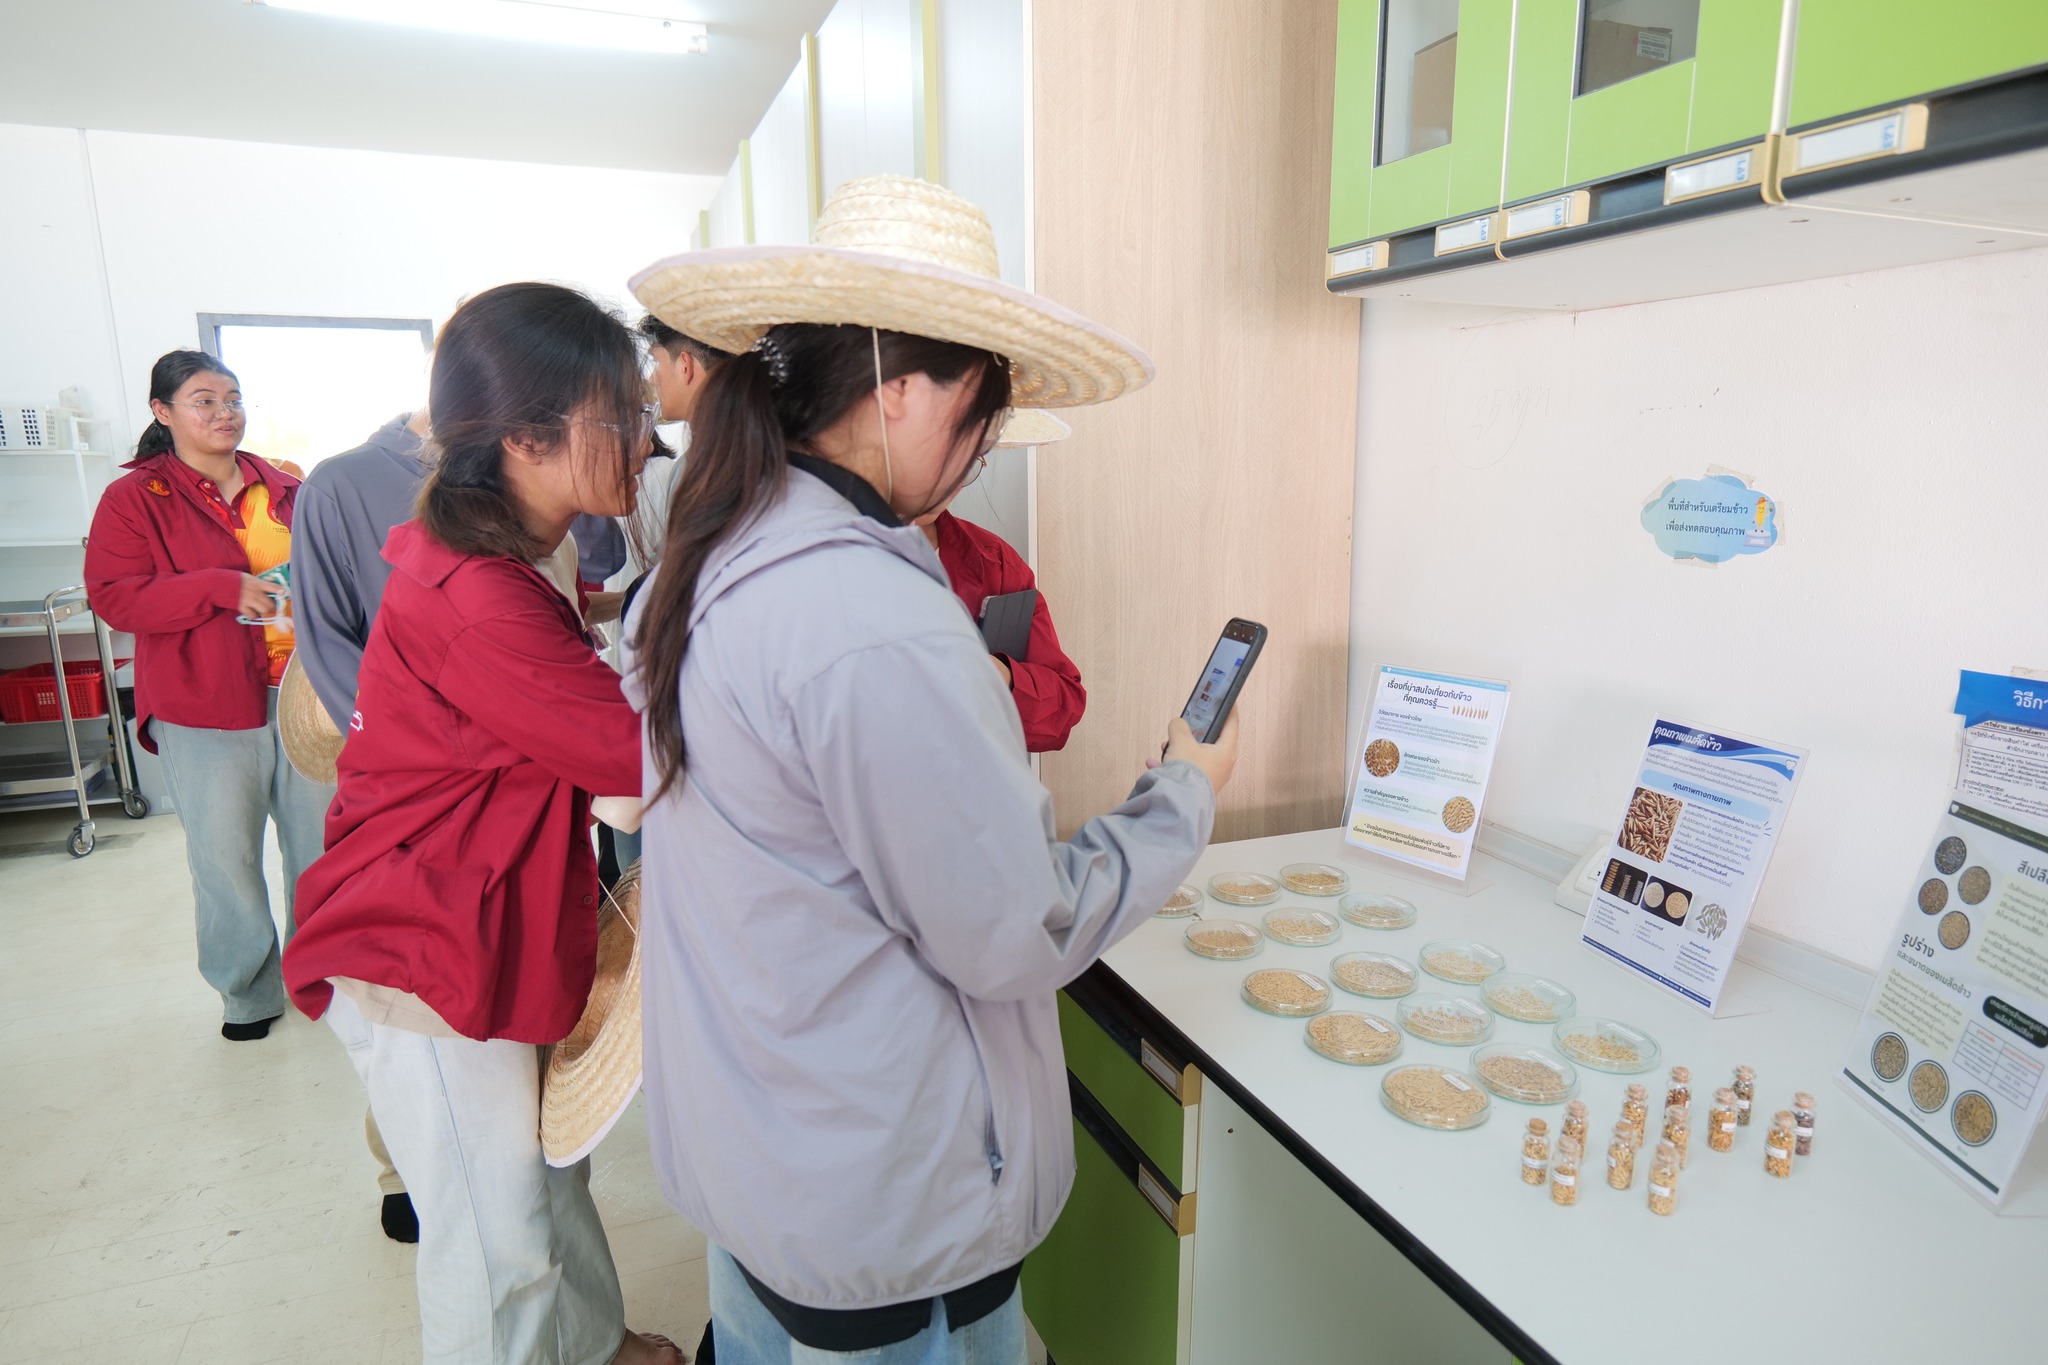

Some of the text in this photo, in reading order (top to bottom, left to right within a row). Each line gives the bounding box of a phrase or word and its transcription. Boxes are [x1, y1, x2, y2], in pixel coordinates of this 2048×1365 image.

[1668, 497, 1748, 515] พื้นที่สำหรับเตรียมข้าว
[1666, 519, 1745, 537] เพื่อส่งทดสอบคุณภาพ
[1654, 726, 1722, 752] คุณภาพเมล็ดข้าว
[1672, 782, 1732, 806] คุณภาพทางกายภาพ
[1901, 933, 1935, 958] รูปร่าง
[1897, 950, 1972, 999] และขนาดของเมล็ดข้าว
